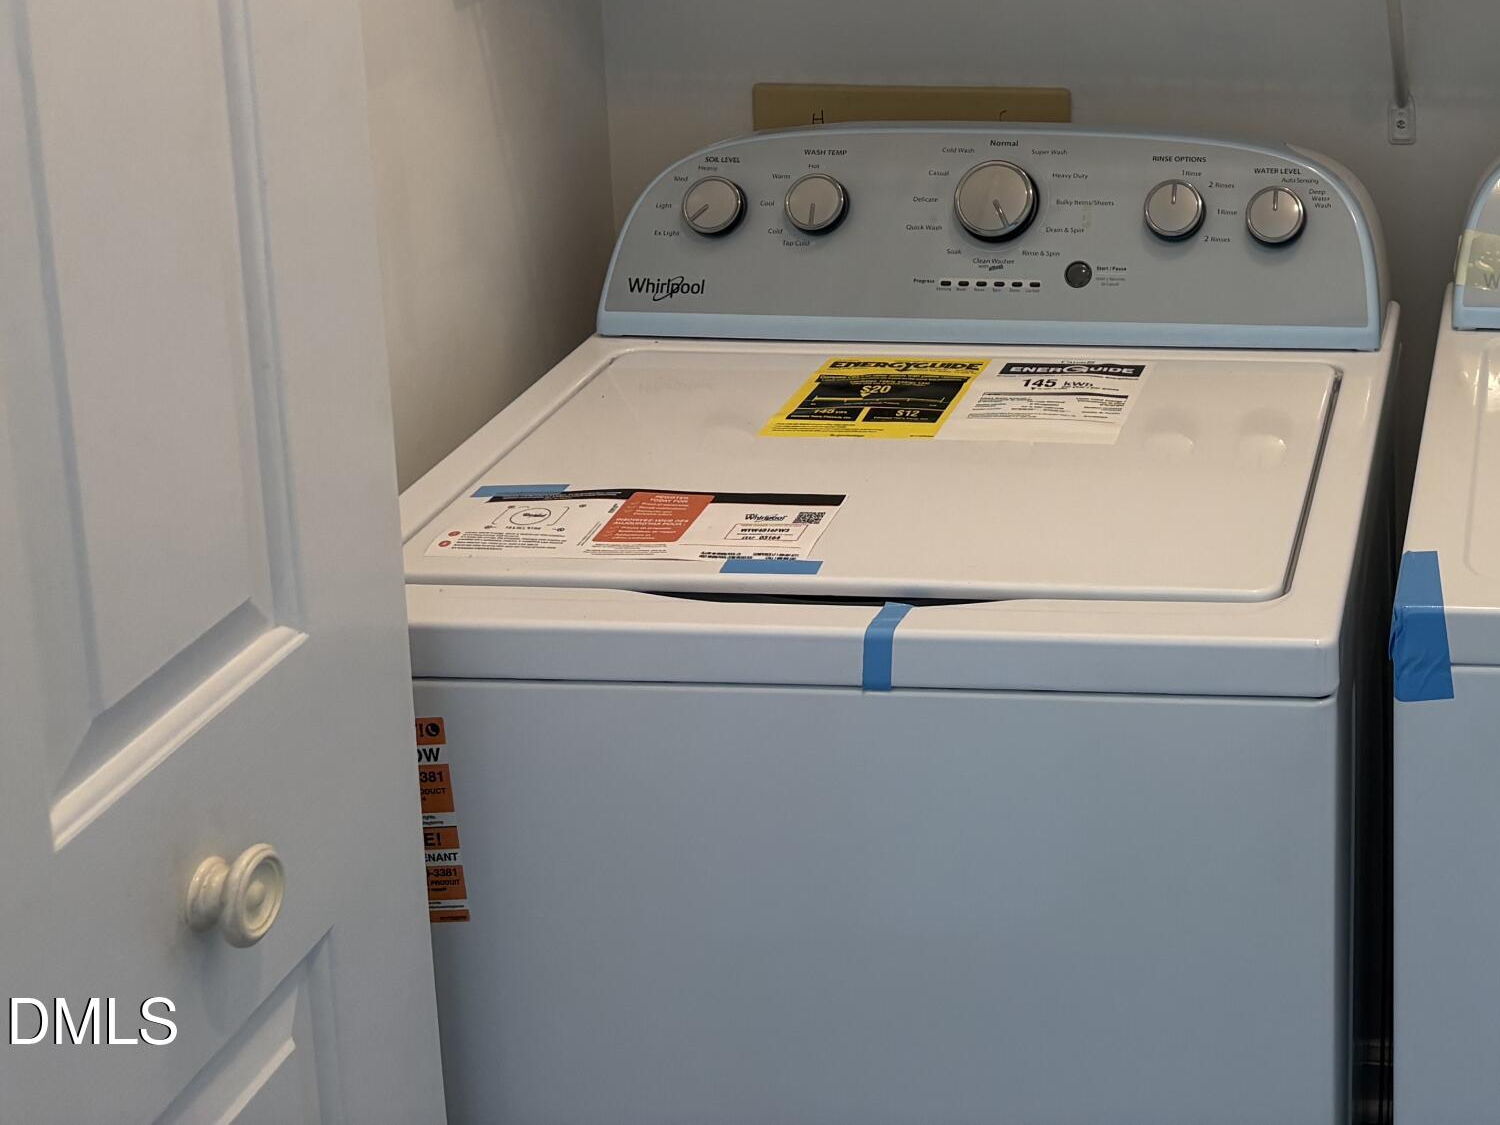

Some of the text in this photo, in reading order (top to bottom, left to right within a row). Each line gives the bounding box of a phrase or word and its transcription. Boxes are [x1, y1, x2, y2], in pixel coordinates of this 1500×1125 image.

[990, 139, 1019, 147] Normal
[656, 203, 672, 211] Light
[1056, 199, 1115, 207] Bulky Items/Sheets
[906, 224, 925, 232] Quick
[663, 230, 680, 238] Light
[783, 240, 794, 248] Tap
[628, 275, 705, 301] Whirlpool
[829, 361, 983, 372] ENERGYGUIDE
[1010, 365, 1135, 374] ENERGUIDE
[1023, 379, 1057, 387] 145
[860, 385, 892, 394] $20
